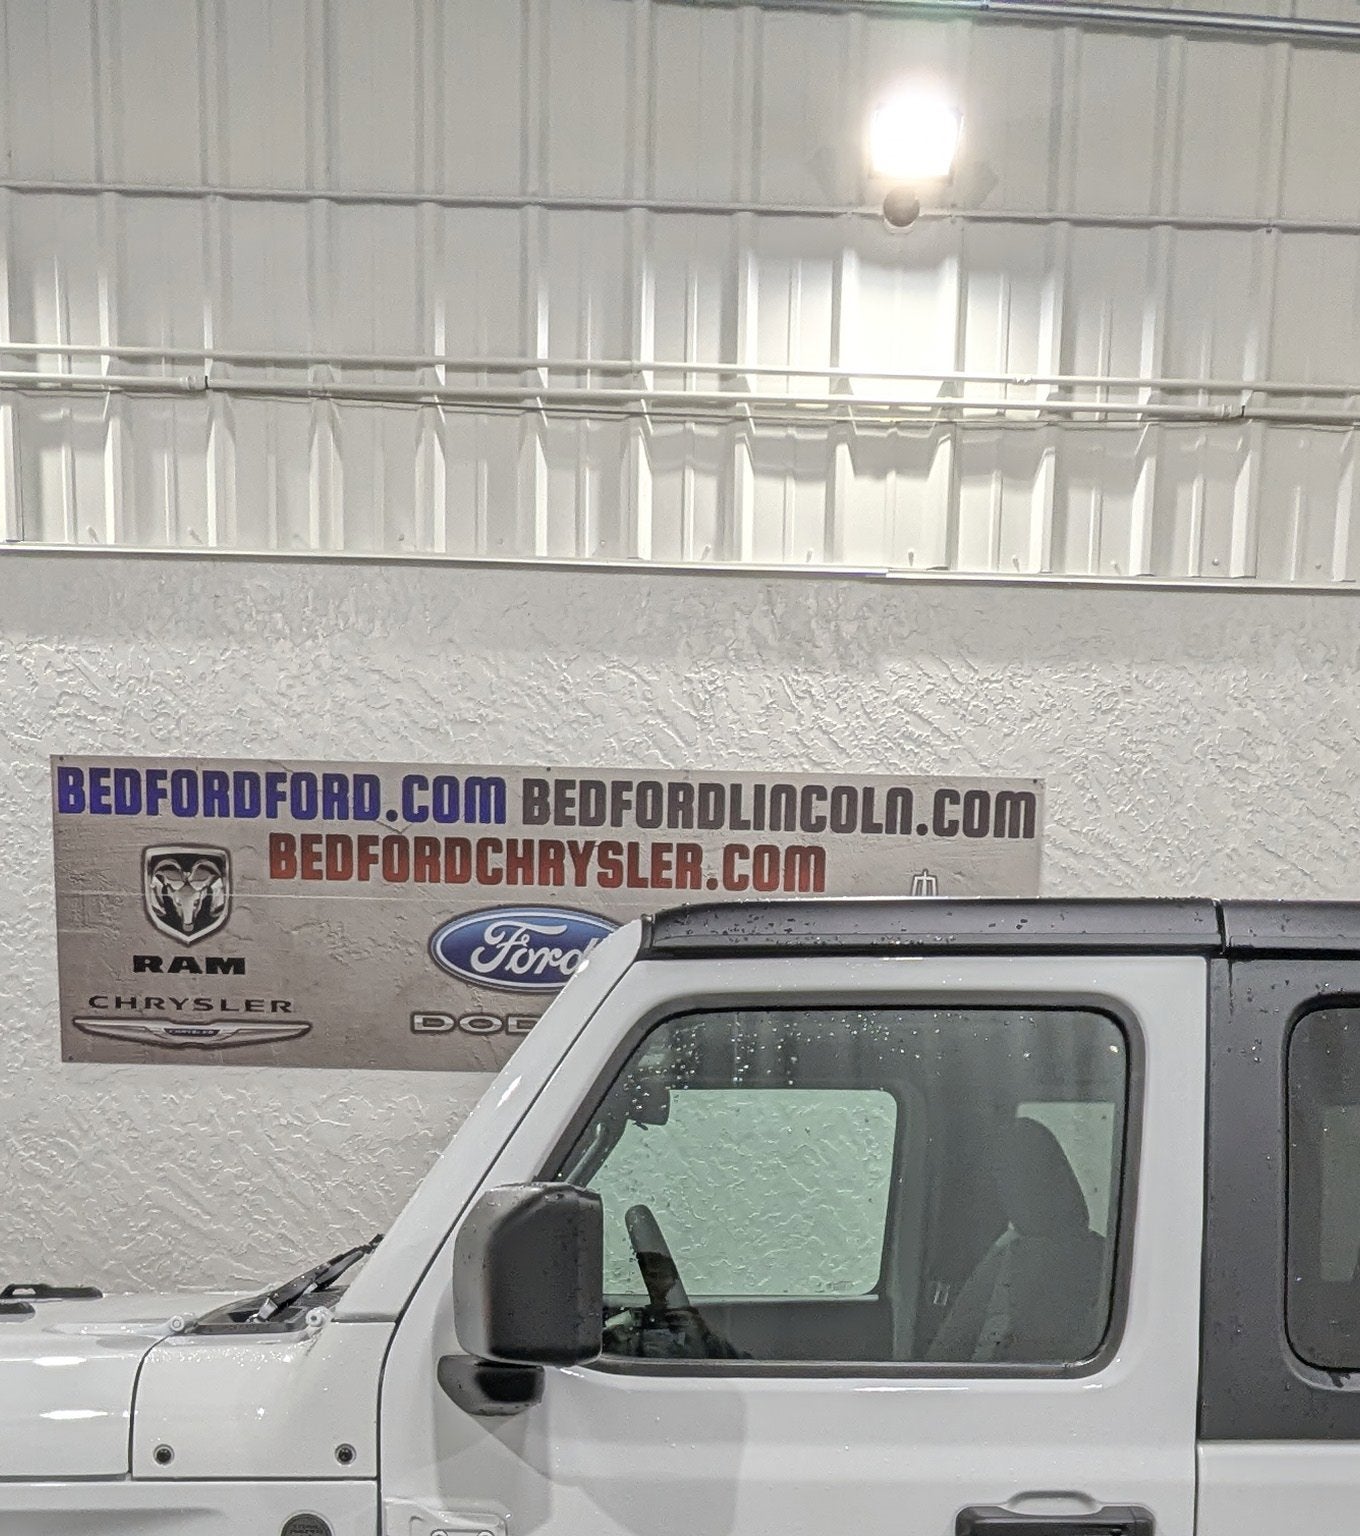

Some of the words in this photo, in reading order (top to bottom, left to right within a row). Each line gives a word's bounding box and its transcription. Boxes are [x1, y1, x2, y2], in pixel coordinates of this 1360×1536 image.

[56, 766, 507, 824] BEDFORDFORD.COM
[522, 778, 1037, 838] BEDFORDLINCOLN.COM
[269, 832, 827, 892] BEDFORDCHRYSLER.COM
[132, 955, 246, 975] RAM
[88, 996, 292, 1014] CHRYSLER
